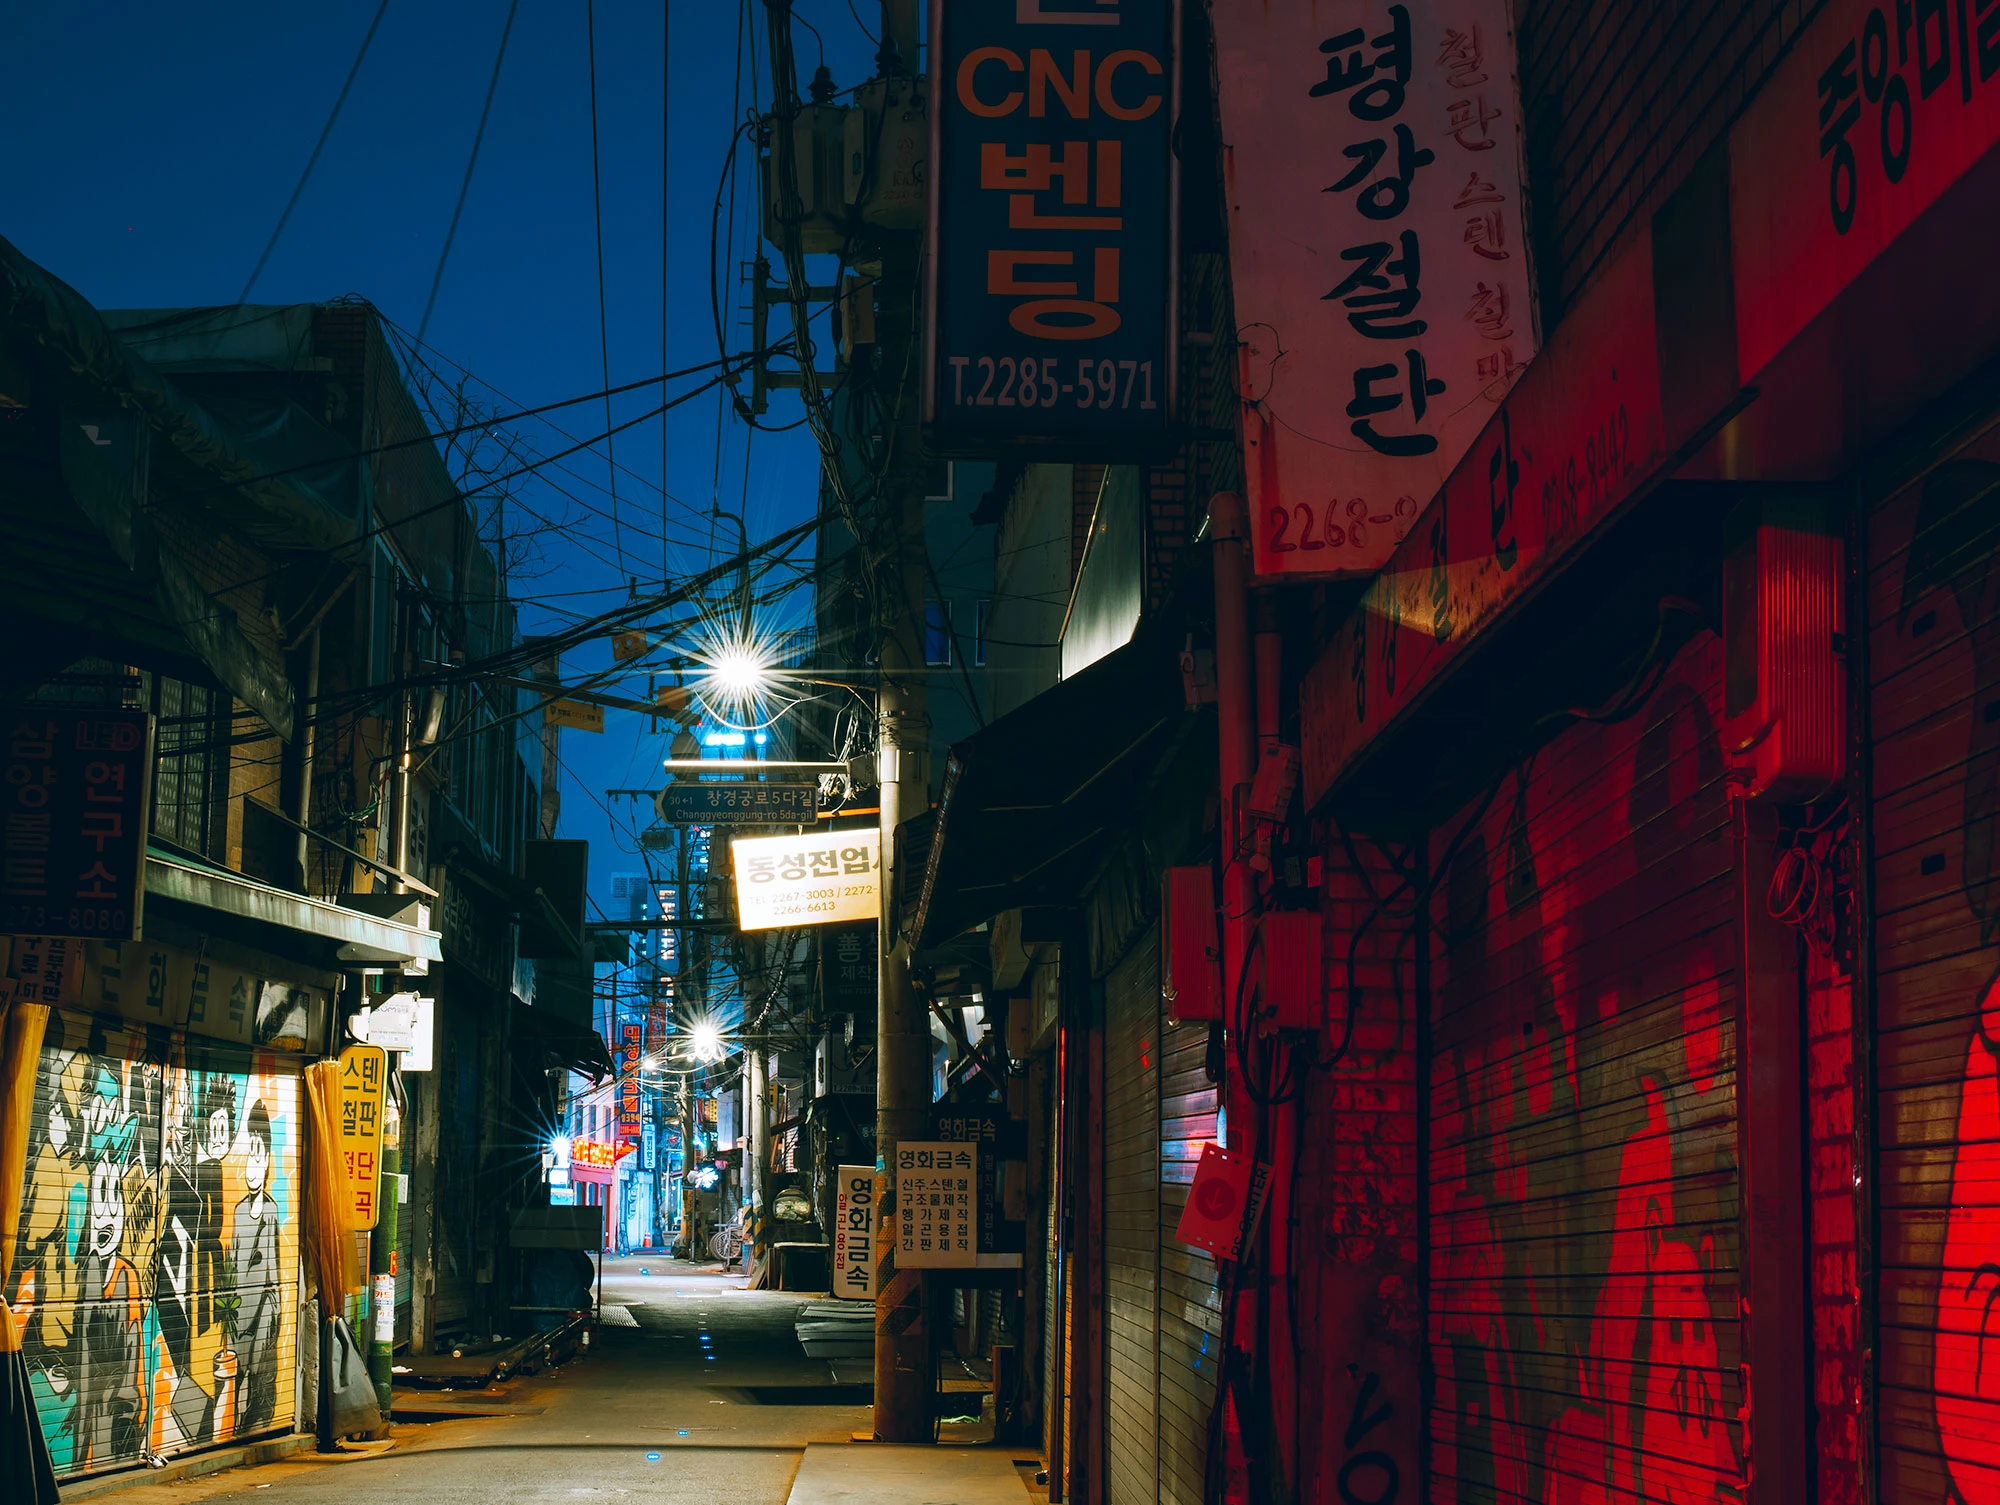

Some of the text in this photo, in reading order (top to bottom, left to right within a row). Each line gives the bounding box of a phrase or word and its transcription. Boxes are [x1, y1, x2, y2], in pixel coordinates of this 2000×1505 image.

[956, 46, 1163, 121] CNC
[1435, 24, 1502, 152] 철판
[1818, 0, 2000, 236] 중앙미
[980, 140, 1122, 340] 벤딩
[1309, 5, 1446, 457] 평강절단
[1453, 171, 1511, 260] 스텐
[949, 356, 1157, 410] T.2285-5971
[76, 760, 127, 899] 연구소
[779, 809, 812, 820] 5da-gil
[772, 888, 834, 903] 2267-3003
[773, 901, 836, 915] 2266-6613
[343, 1056, 379, 1093] 스텐
[343, 1100, 377, 1137] 철판
[939, 1118, 996, 1143] 영화금속
[899, 1150, 972, 1169] 영화금속
[350, 1190, 371, 1220] 곡
[846, 1178, 873, 1291] 영화금속
